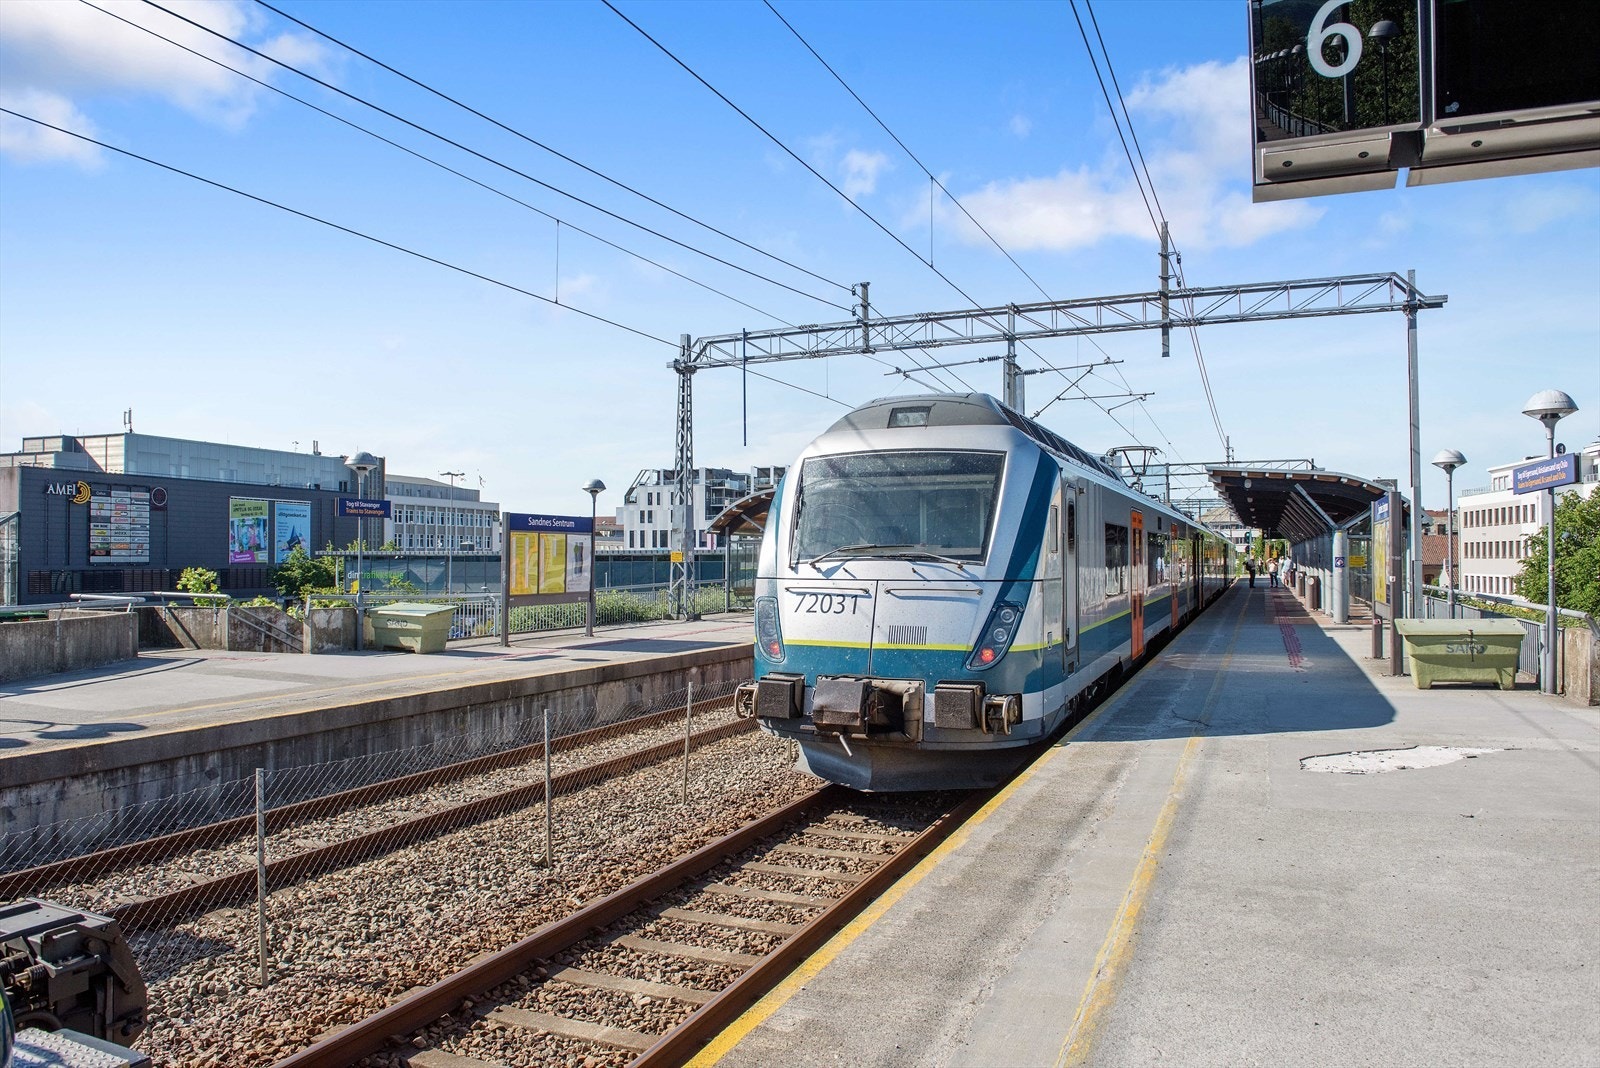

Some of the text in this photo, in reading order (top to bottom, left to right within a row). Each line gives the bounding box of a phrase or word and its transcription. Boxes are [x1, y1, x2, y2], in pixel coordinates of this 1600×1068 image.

[1307, 0, 1363, 78] 6
[46, 482, 76, 496] AMFI
[528, 517, 575, 527] Sandnes Sentrum
[794, 594, 860, 614] 72031
